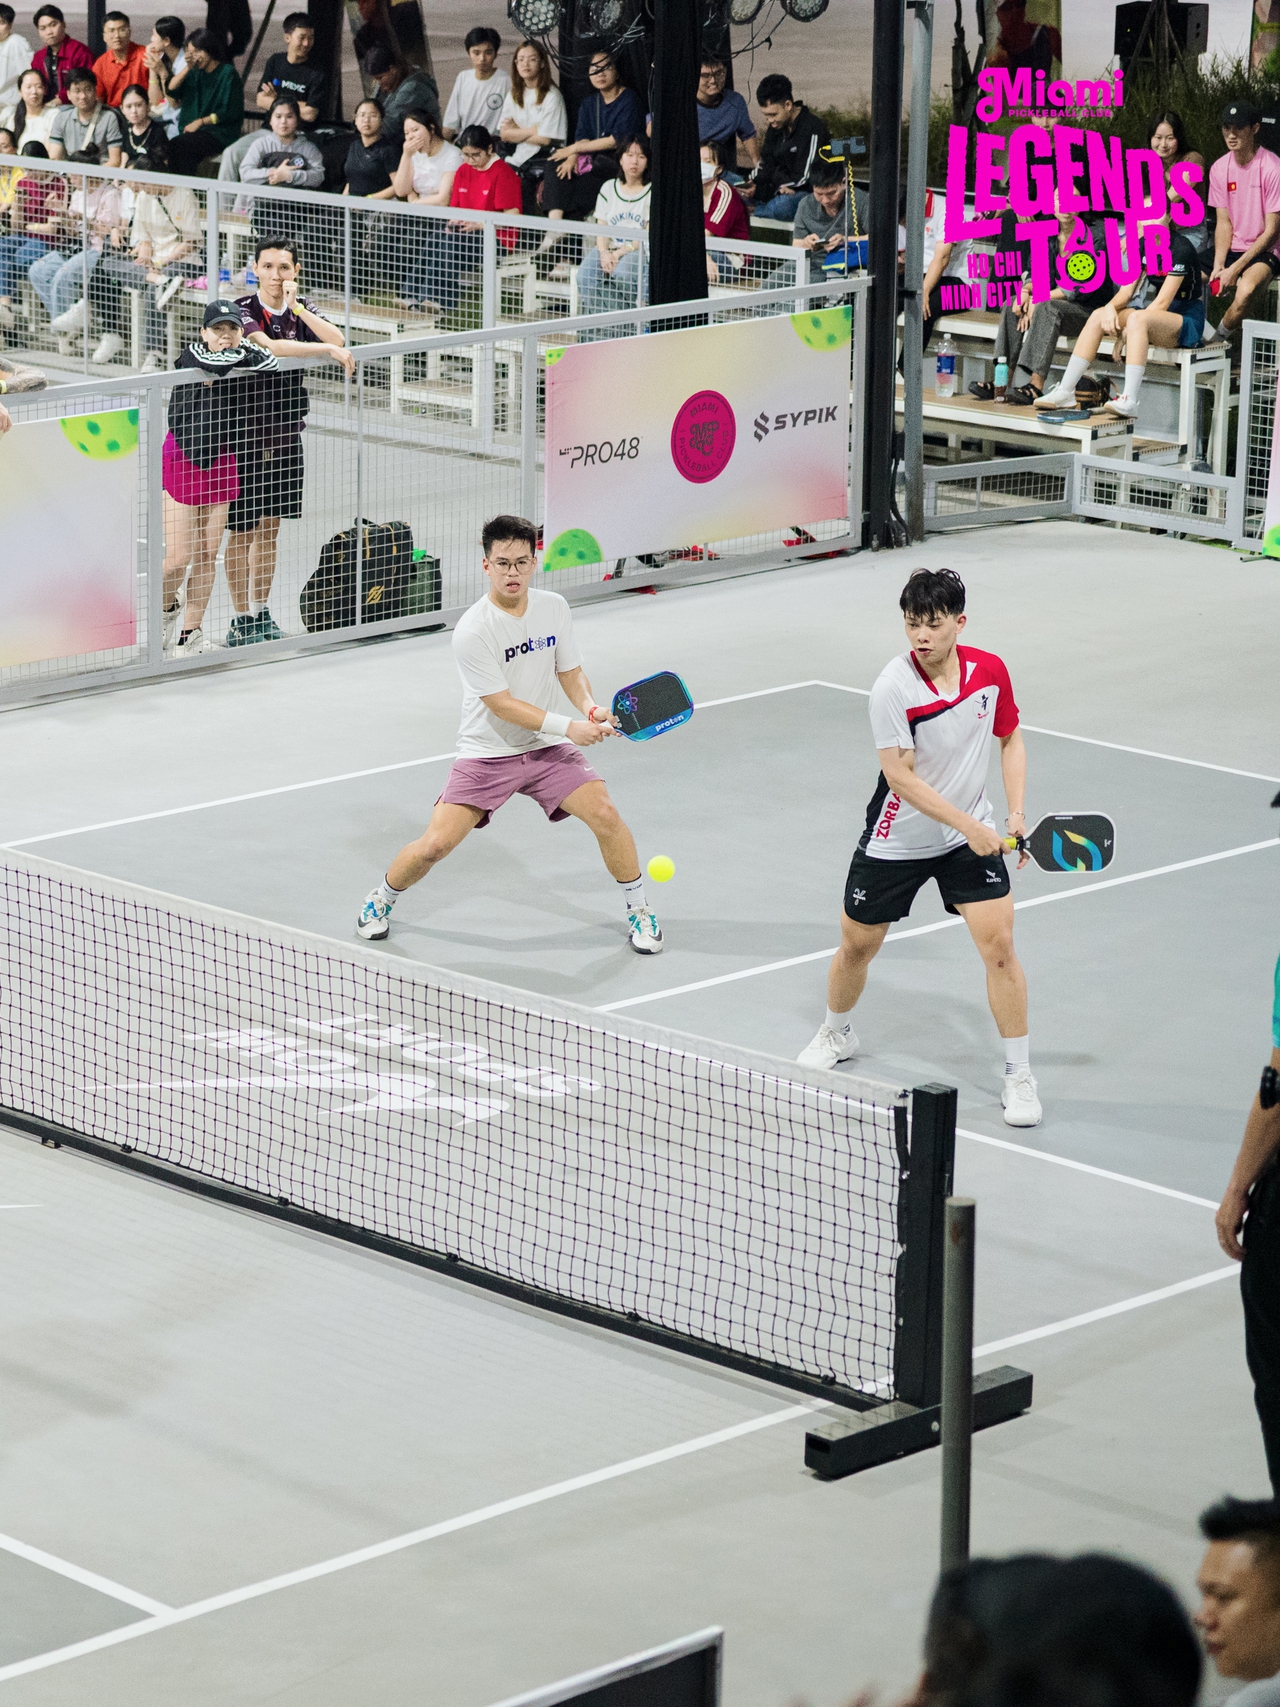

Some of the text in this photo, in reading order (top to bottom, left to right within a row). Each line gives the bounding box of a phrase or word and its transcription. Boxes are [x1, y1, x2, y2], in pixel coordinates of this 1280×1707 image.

[689, 402, 719, 417] MIAMI
[773, 405, 838, 431] SYPIK
[679, 430, 729, 473] PICKLEBALL CLUB
